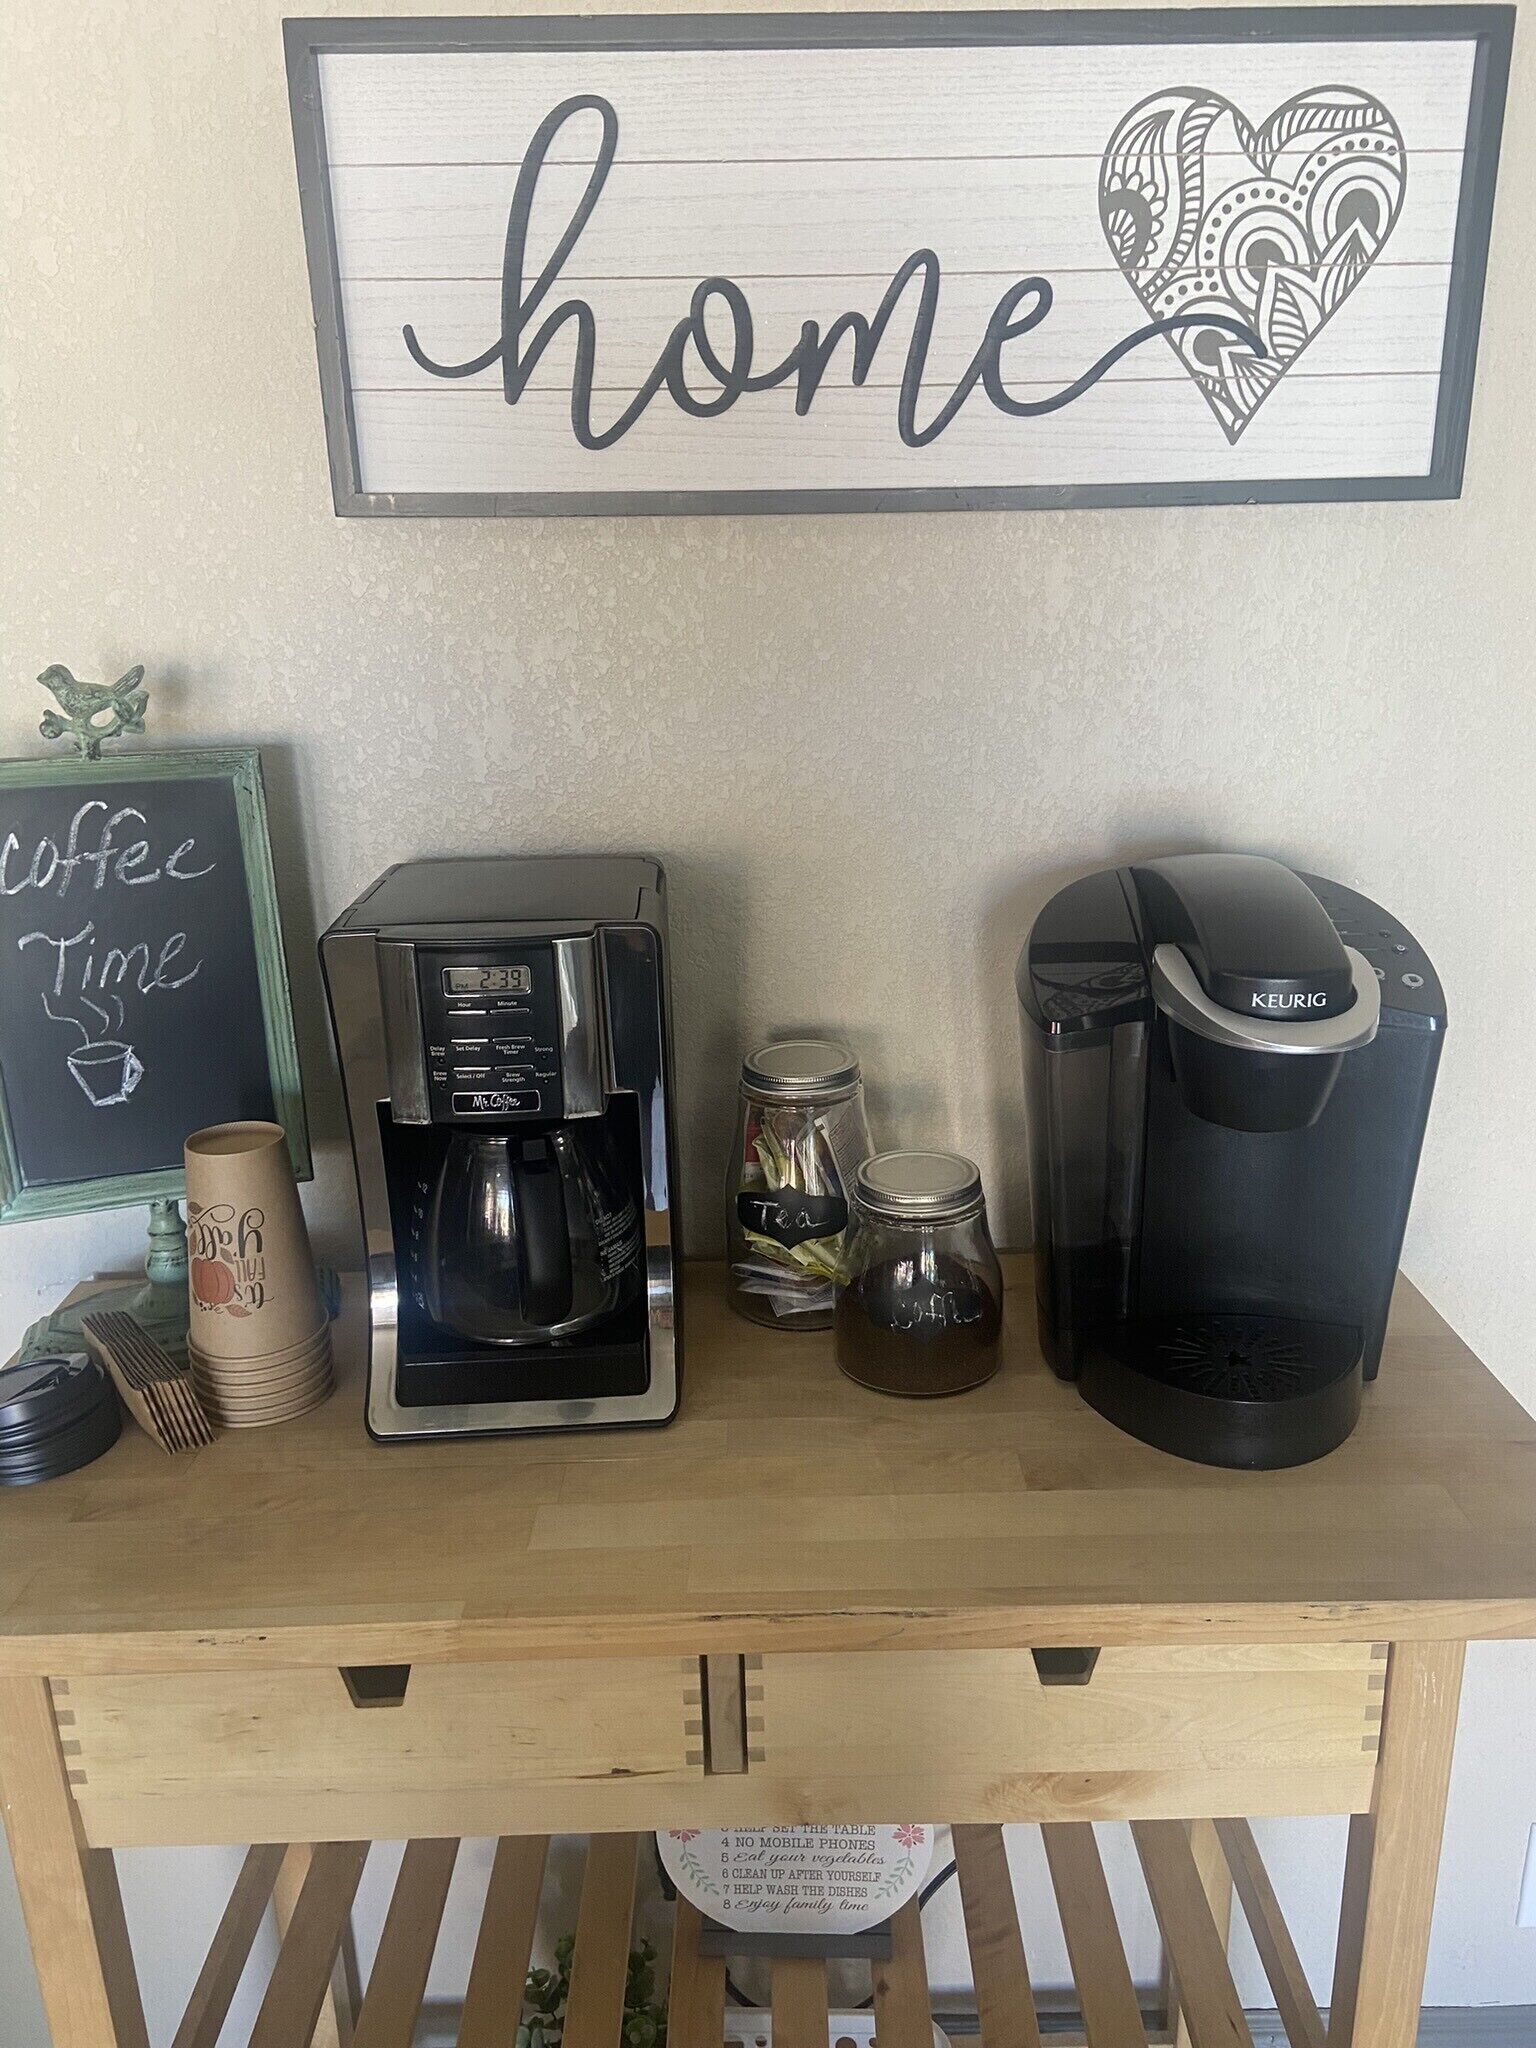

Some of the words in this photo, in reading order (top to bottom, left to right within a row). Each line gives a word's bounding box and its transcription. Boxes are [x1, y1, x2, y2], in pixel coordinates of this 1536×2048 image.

[402, 94, 1267, 449] home
[18, 920, 203, 996] Time
[480, 969, 521, 988] 2:39
[1251, 992, 1327, 1009] KEURIG
[472, 1094, 490, 1110] Mr.
[490, 1093, 521, 1112] Coffee
[750, 1200, 829, 1230] Tea
[234, 1256, 266, 1283] FALL
[801, 1825, 828, 1834] THE
[832, 1825, 876, 1835] TABLE
[721, 1837, 729, 1848] 4
[735, 1837, 755, 1848] NO
[759, 1837, 814, 1849] MOBILE
[819, 1838, 876, 1850] PHONES
[721, 1852, 729, 1862] 5
[733, 1850, 766, 1862] Eat
[764, 1853, 806, 1867] your
[812, 1852, 886, 1867] vegetables
[722, 1868, 729, 1878] 6
[732, 1868, 767, 1879] CLEAN
[771, 1869, 786, 1879] UP
[788, 1869, 823, 1880] AFTER
[826, 1870, 881, 1882] YOURSELF
[723, 1884, 730, 1894] 7
[733, 1884, 763, 1894] HELP
[766, 1885, 798, 1896] WASH
[802, 1885, 824, 1896] THE
[828, 1886, 868, 1897] DISHES
[723, 1899, 731, 1909] 8
[734, 1899, 782, 1913] Enjoy
[783, 1897, 833, 1914] family
[839, 1899, 870, 1911] time
